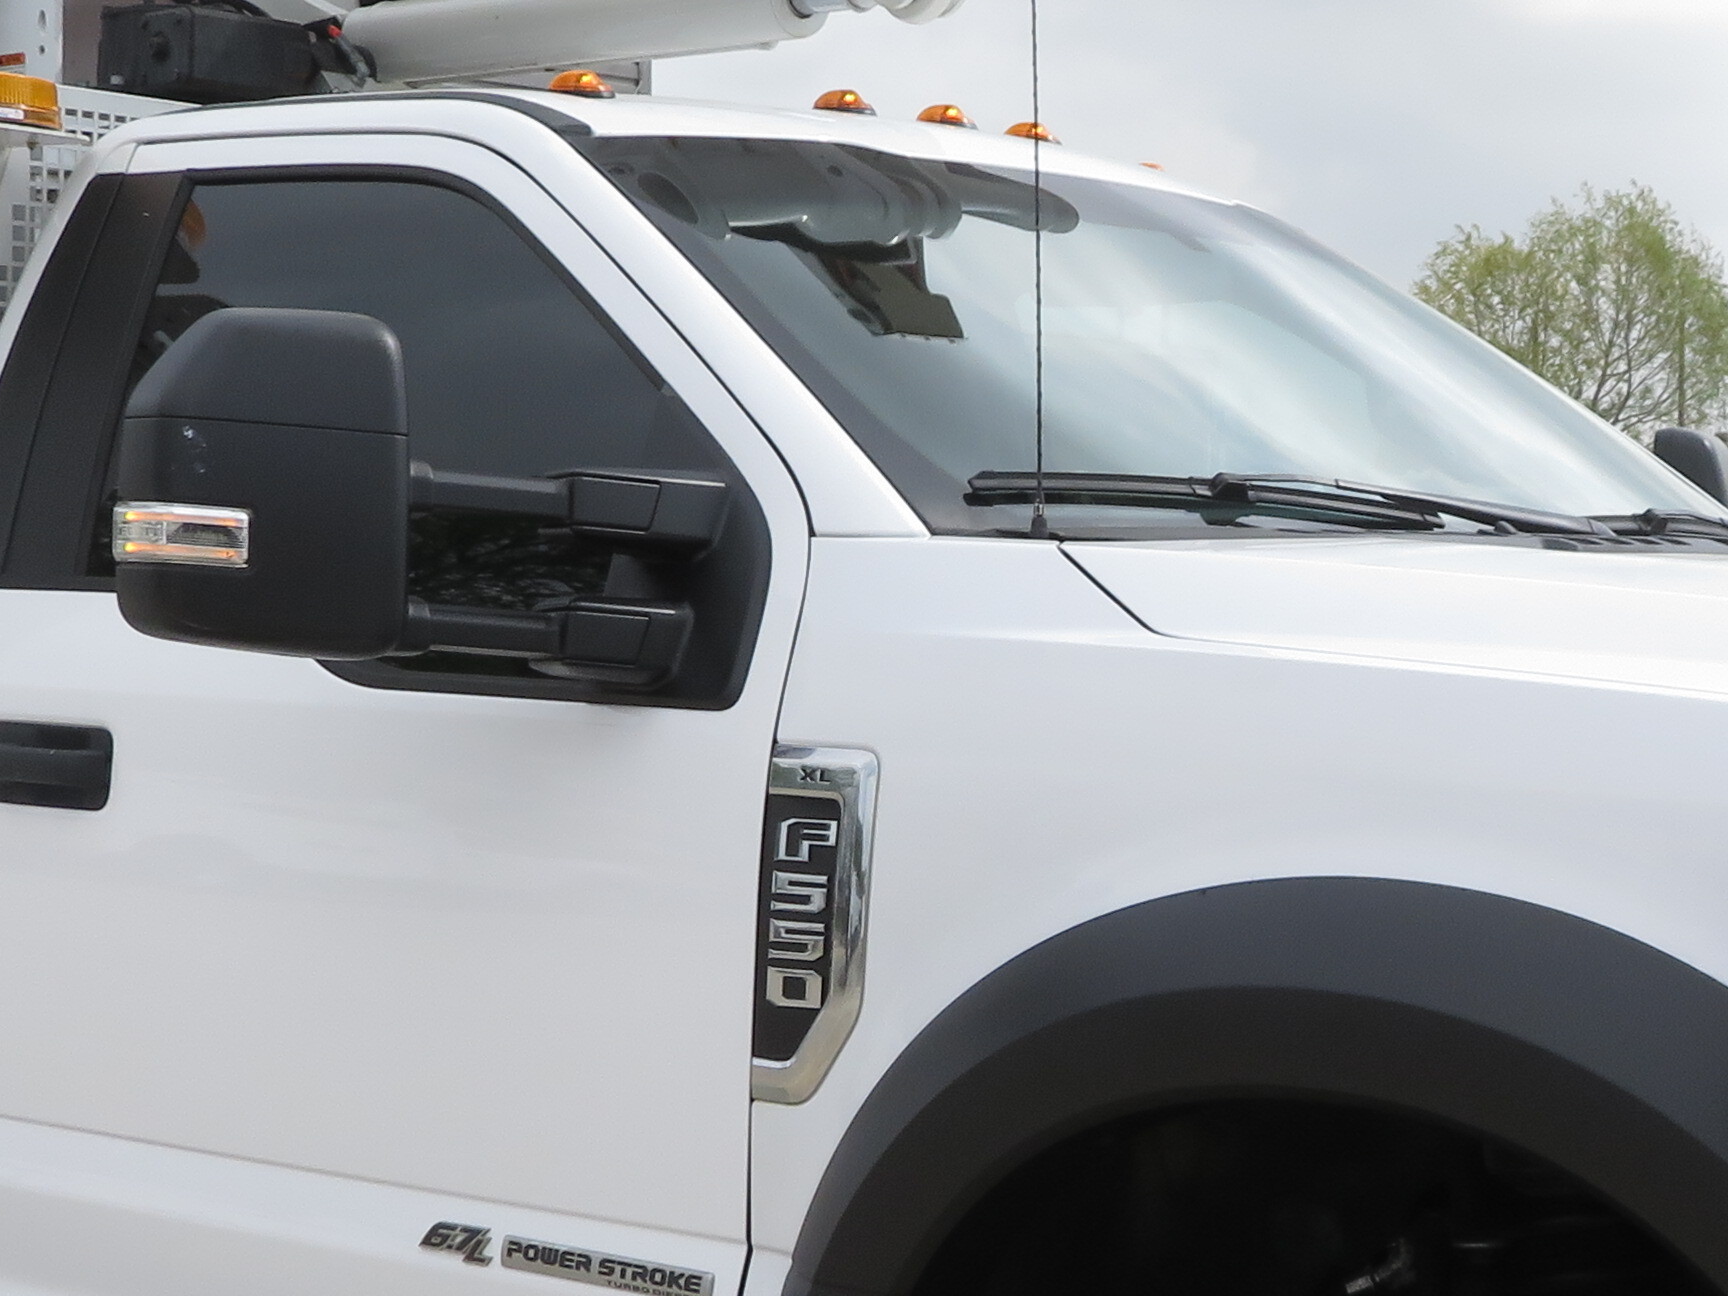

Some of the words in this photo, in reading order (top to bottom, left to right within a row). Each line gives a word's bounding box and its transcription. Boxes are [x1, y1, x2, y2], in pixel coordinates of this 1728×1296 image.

[798, 765, 831, 784] XL
[505, 1240, 592, 1273] POWER
[597, 1257, 703, 1294] STROKE
[606, 1280, 650, 1295] TURBO
